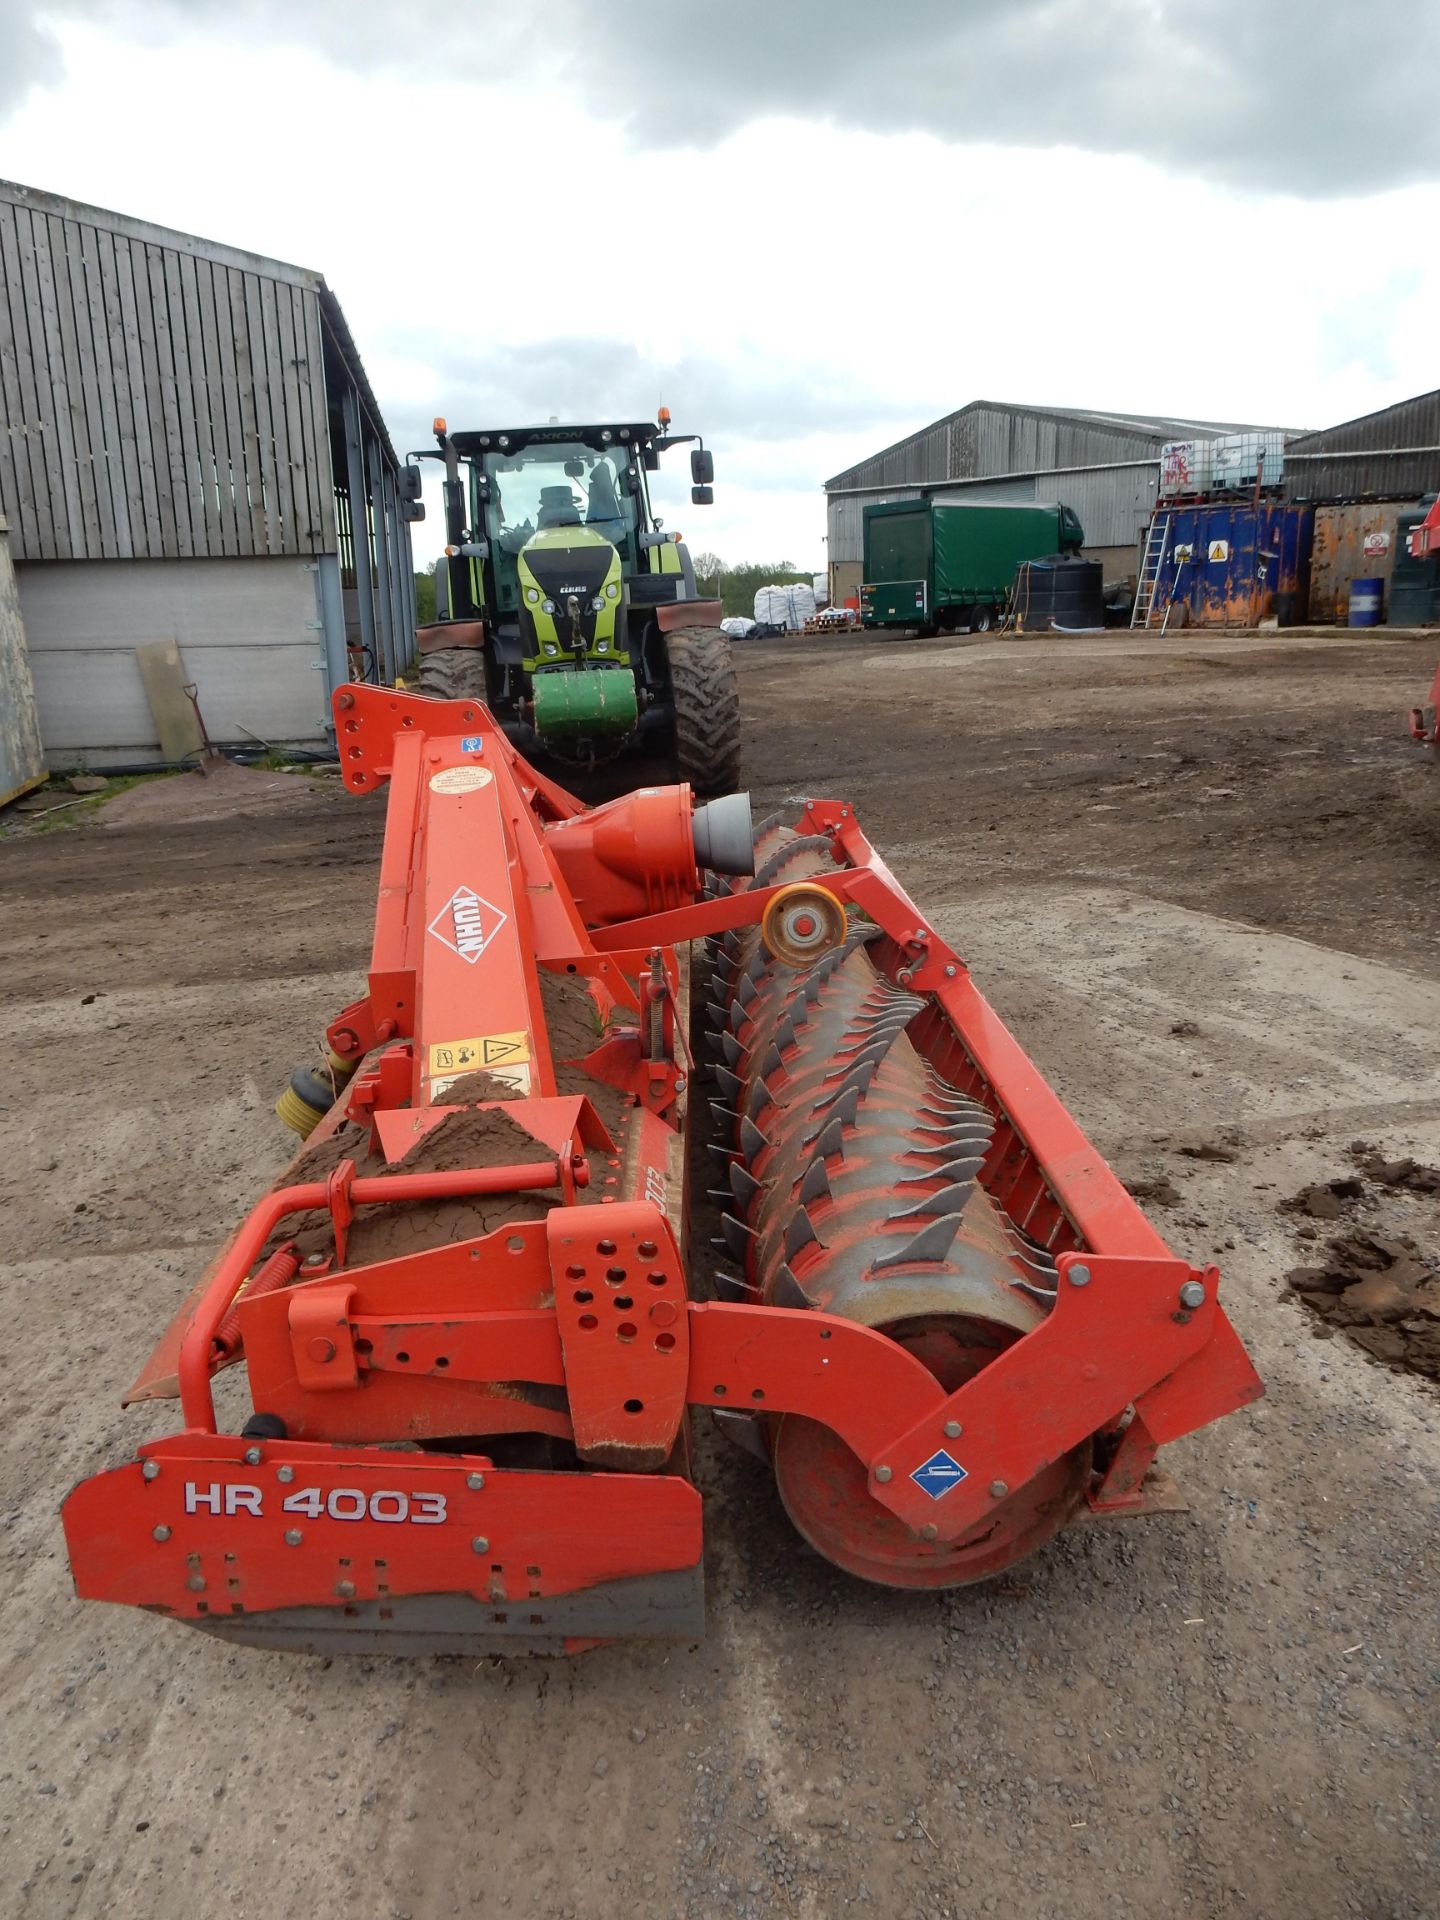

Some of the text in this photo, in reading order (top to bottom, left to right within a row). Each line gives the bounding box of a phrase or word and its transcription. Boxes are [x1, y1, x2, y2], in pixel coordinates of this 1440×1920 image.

[528, 431, 583, 441] AXION
[452, 894, 484, 954] KUHN
[184, 1481, 449, 1525] HR 4003
